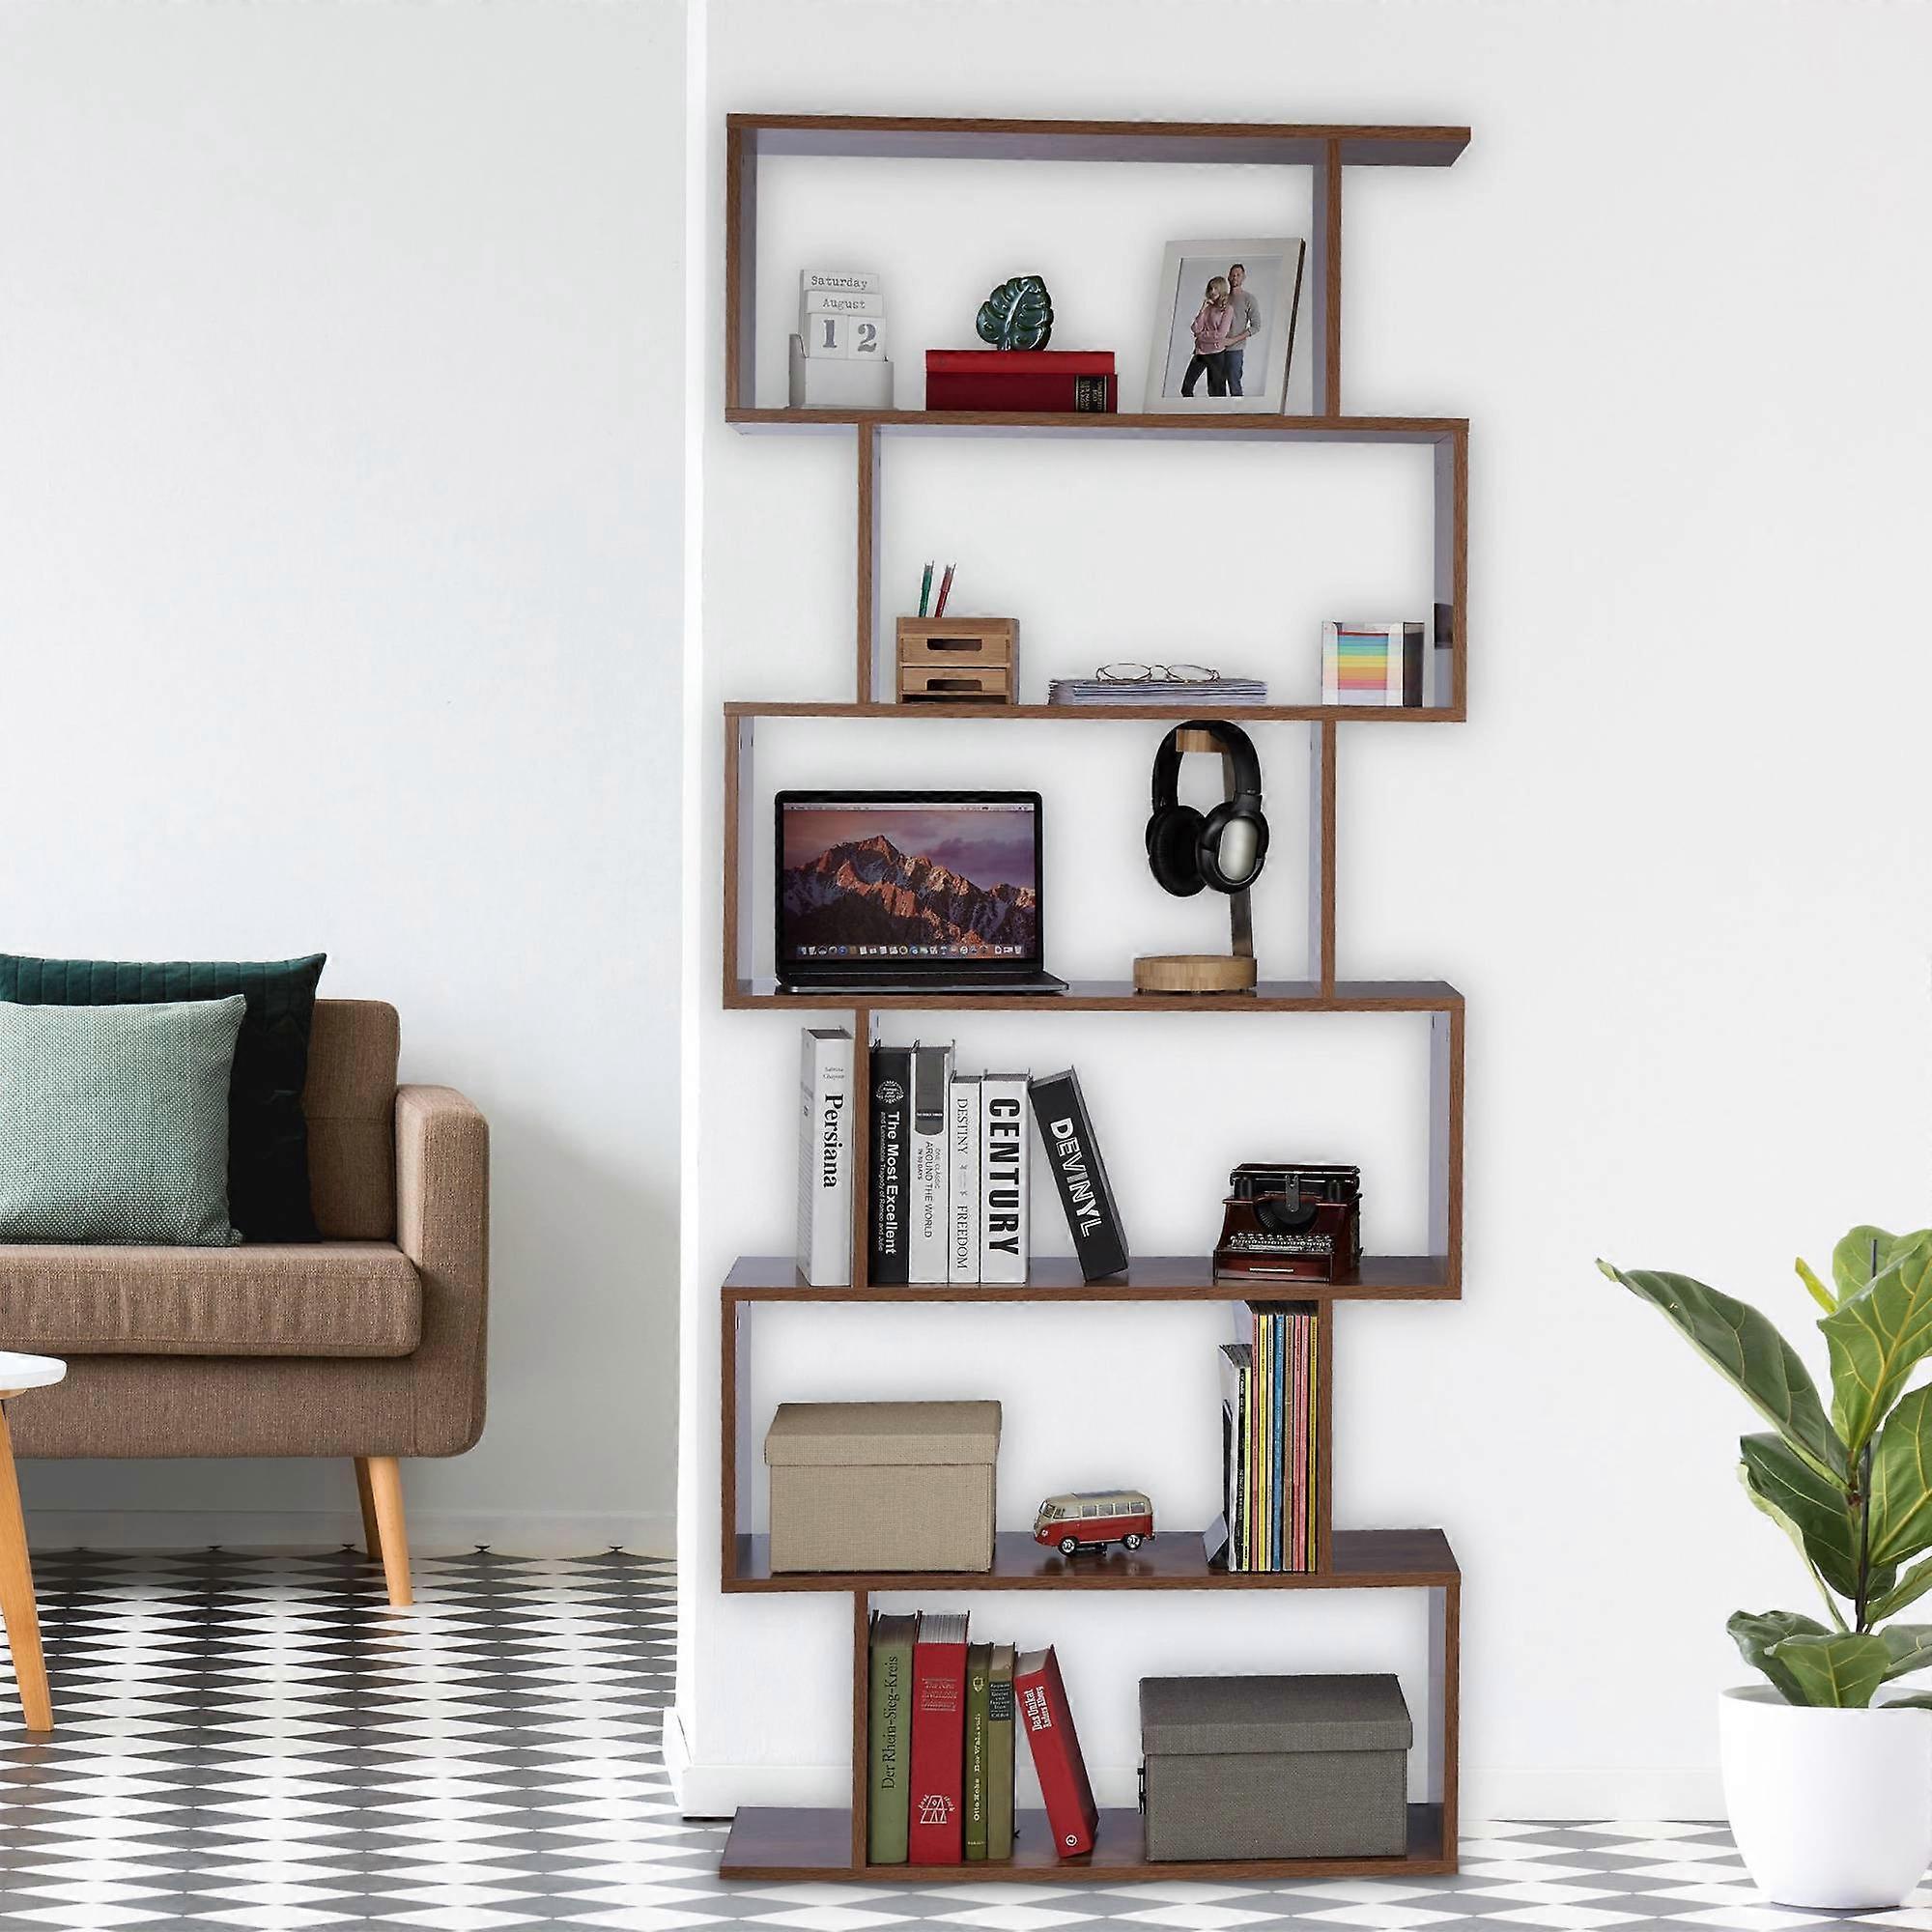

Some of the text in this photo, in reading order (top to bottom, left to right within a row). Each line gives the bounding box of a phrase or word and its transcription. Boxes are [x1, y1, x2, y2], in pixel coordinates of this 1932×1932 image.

[811, 275, 867, 291] Saturday
[822, 298, 866, 311] August
[823, 1094, 844, 1188] Persiana
[887, 1144, 899, 1180] Most
[888, 1111, 899, 1140] The
[924, 1141, 934, 1238] AROUND THE WORLD
[956, 1098, 968, 1269] DESTINY FREEDOM
[989, 1098, 1021, 1256] CENTURY
[1050, 1118, 1102, 1237] DEVINYL
[886, 1184, 898, 1254] Excellent
[881, 1656, 900, 1790] Der Rhein-Sieg-Kreis
[1024, 1688, 1043, 1732] Das Unikat
